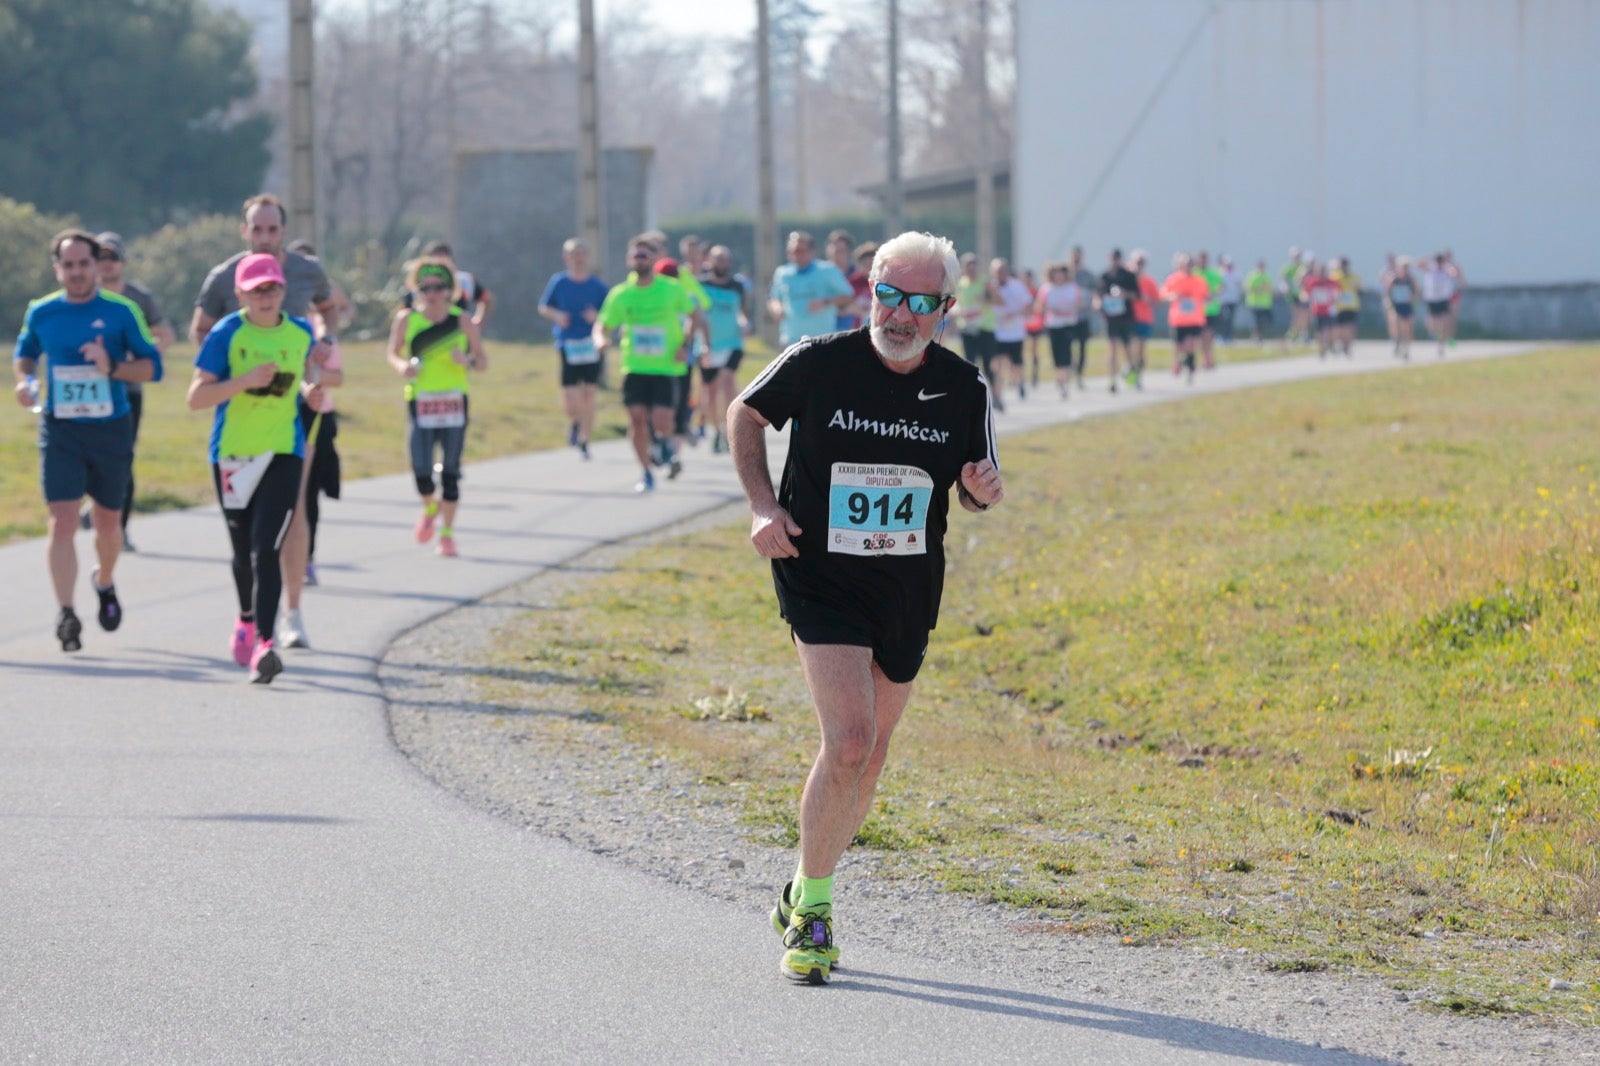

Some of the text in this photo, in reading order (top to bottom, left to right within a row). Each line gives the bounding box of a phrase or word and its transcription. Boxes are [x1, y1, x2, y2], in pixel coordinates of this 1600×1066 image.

[62, 382, 98, 401] 571
[828, 409, 950, 444] Almuñécar
[857, 466, 875, 475] GRAN
[876, 466, 899, 476] PREMIO
[900, 467, 908, 476] DE
[865, 476, 903, 486] DIPUTACIÓN
[848, 492, 913, 526] 914
